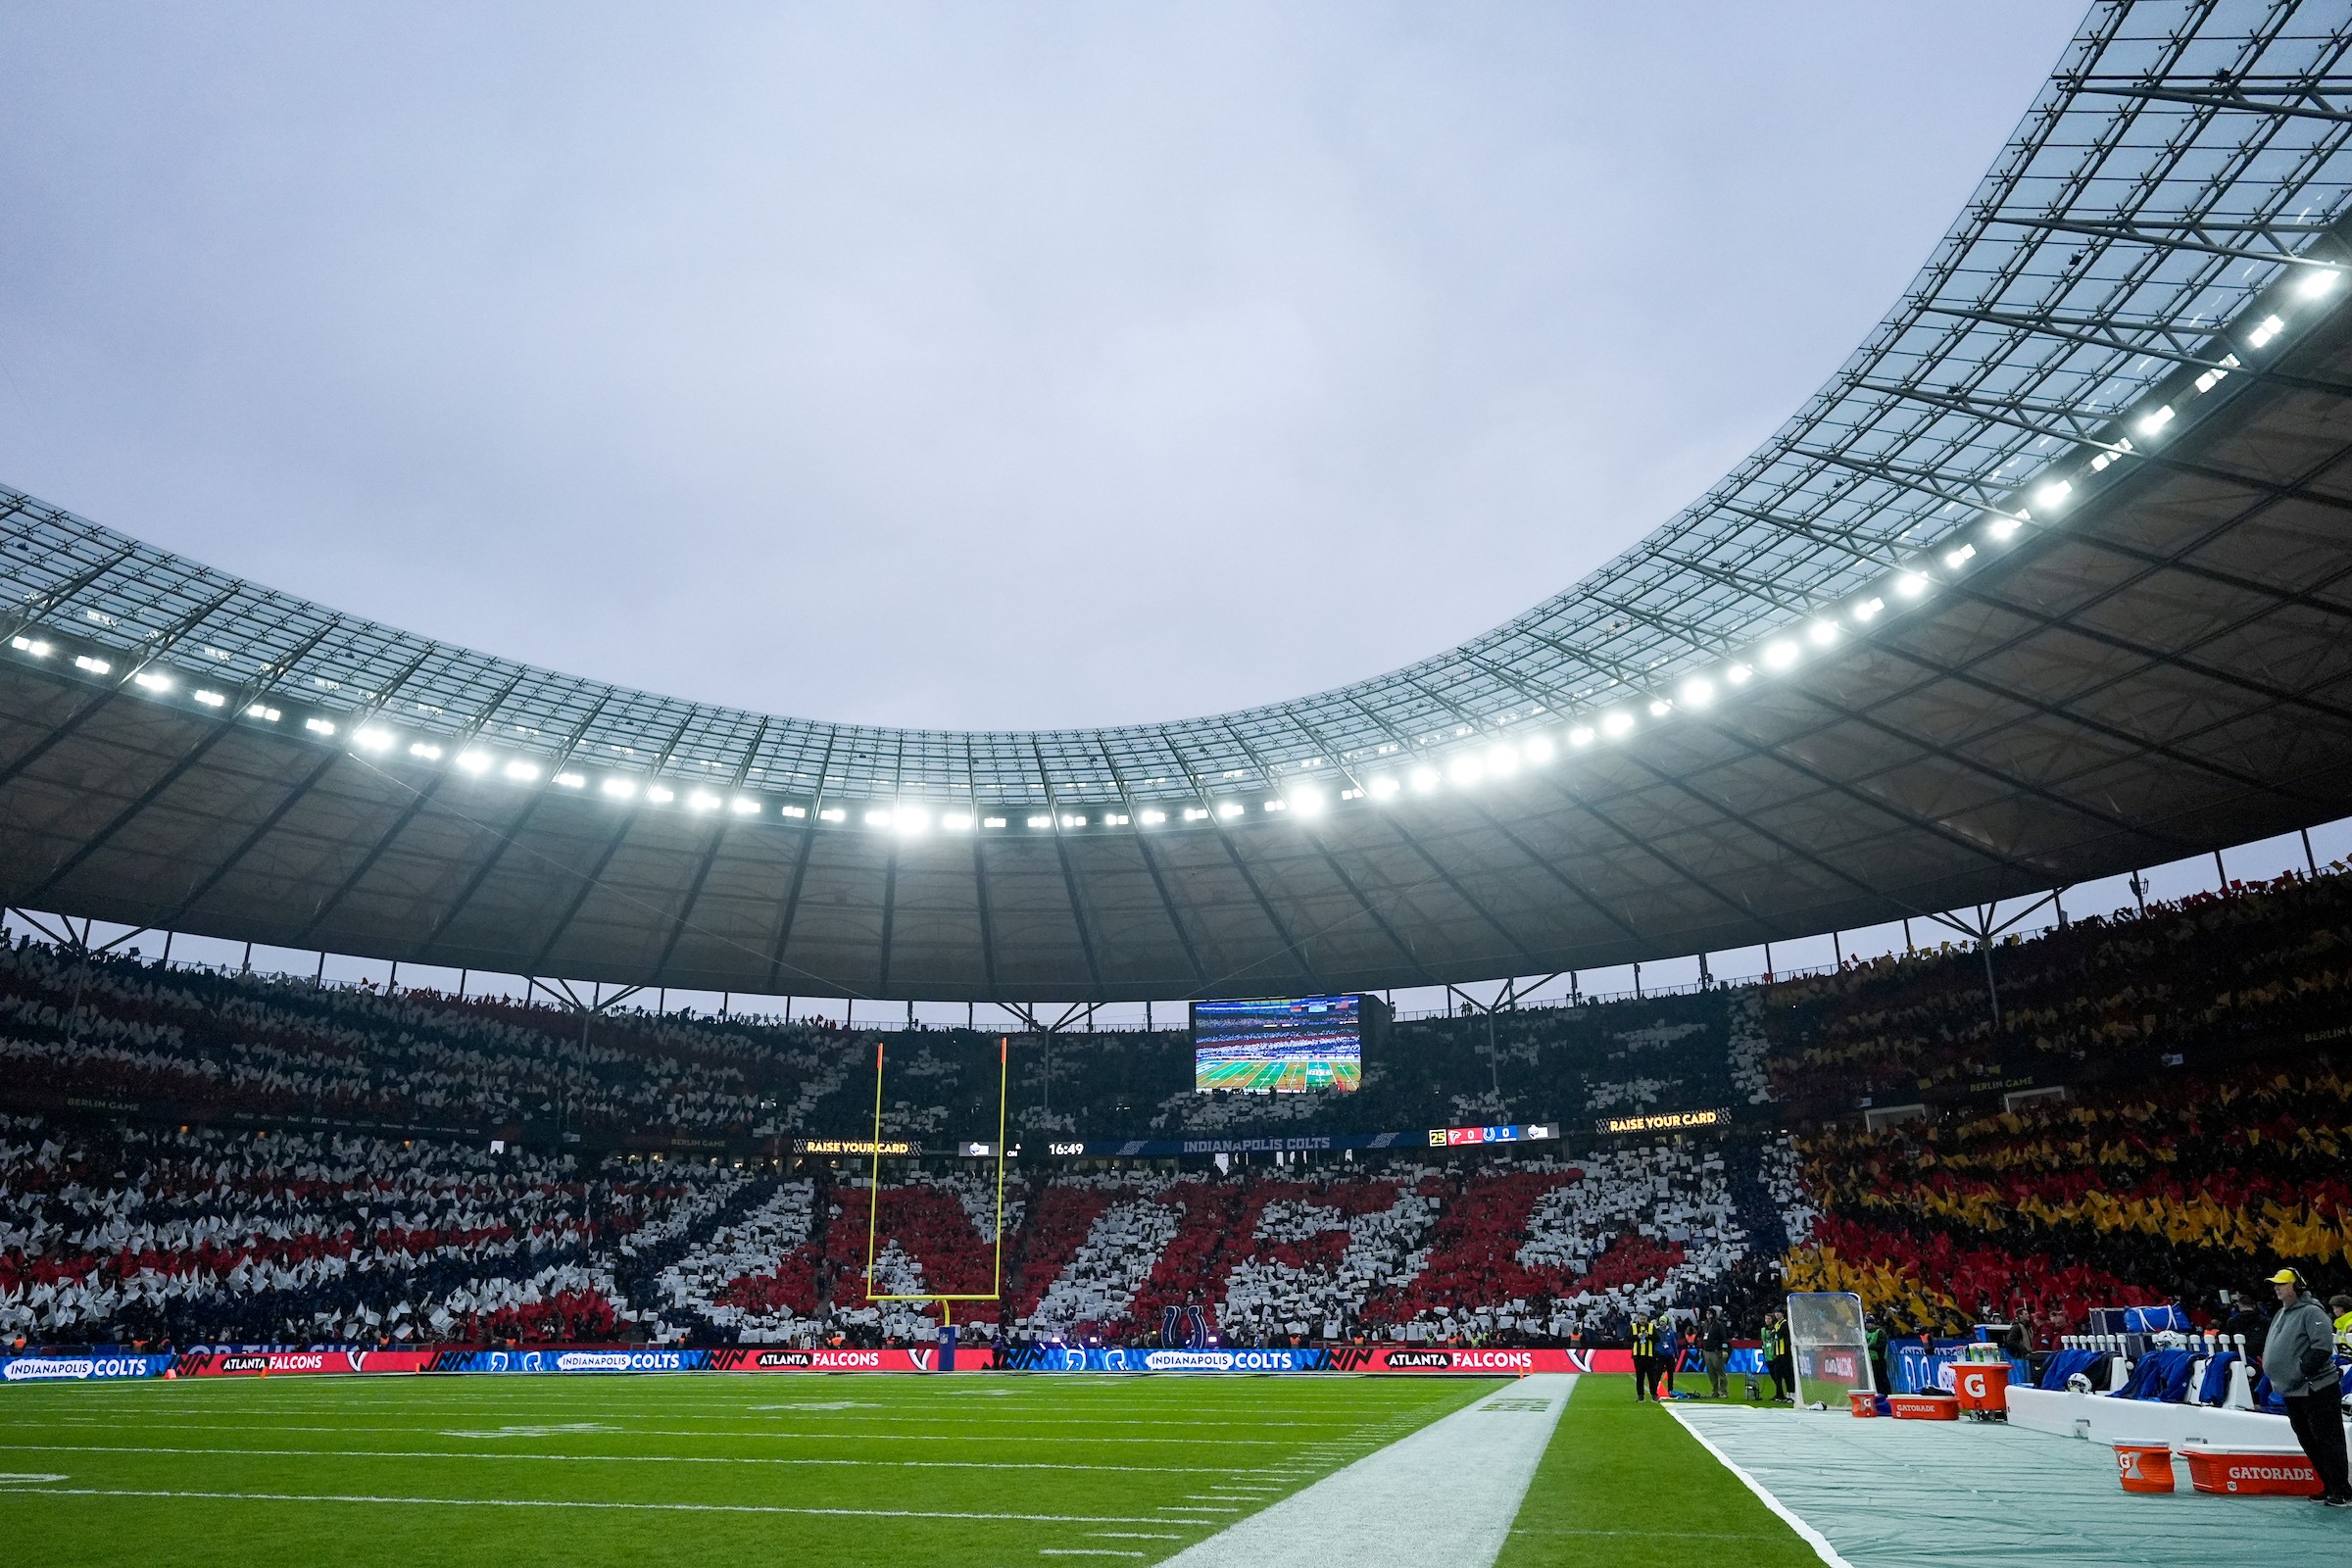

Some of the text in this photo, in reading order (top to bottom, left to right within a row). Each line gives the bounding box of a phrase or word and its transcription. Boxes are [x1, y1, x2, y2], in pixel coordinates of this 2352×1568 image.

[2305, 1027, 2346, 1042] BERLIN
[1970, 1076, 2034, 1092] BERLIN GAME
[67, 1098, 140, 1111] BERLIN GAME
[1610, 1112, 1716, 1132] RAISE YOUR CARD
[1431, 1132, 1446, 1143] 25
[1467, 1130, 1475, 1140] 0
[1501, 1128, 1509, 1137] 0
[670, 1138, 726, 1148] BERLIN GAME
[807, 1142, 908, 1153] RAISE YOUR CARD
[1049, 1144, 1084, 1155] 16:49
[1184, 1137, 1331, 1152] INDIANAPOLIS COLTS
[223, 1355, 323, 1370] ATLANTA FALCONS
[563, 1354, 680, 1369] INDIANAPOLIS COLTS
[760, 1352, 879, 1366] ATLANTA FALCONS
[1152, 1352, 1293, 1369] INDIANAPOLIS COLTS
[1389, 1352, 1533, 1368] ATLANTA FALCONS
[11, 1359, 148, 1376] INDIANAPOLIS COLTS
[1964, 1374, 1986, 1398] G
[1863, 1397, 1872, 1408] G
[1896, 1404, 1936, 1413] GATORADE
[2119, 1453, 2132, 1469] G
[2229, 1467, 2314, 1481] GATORADE
